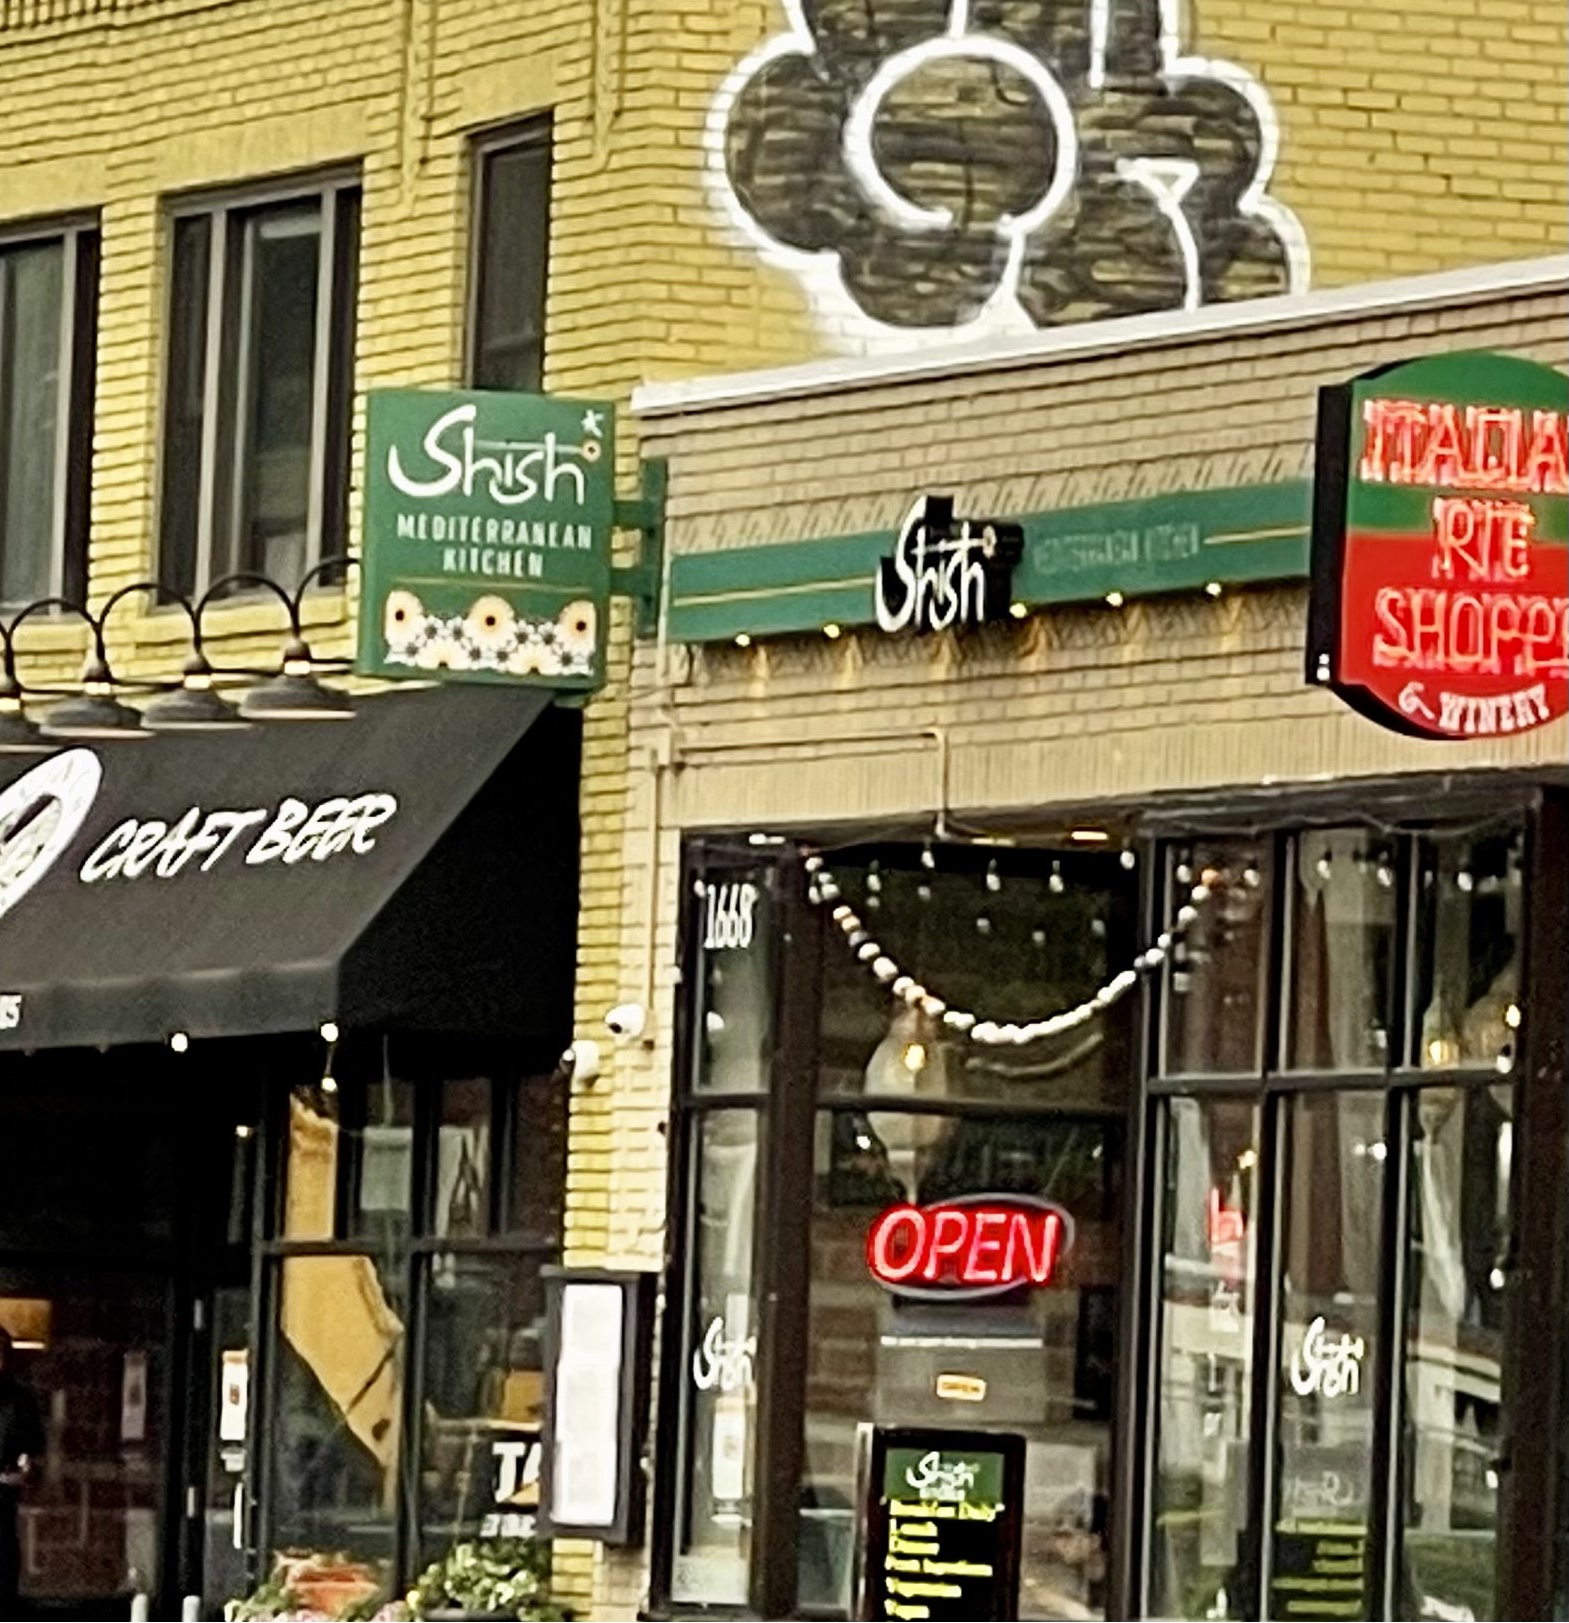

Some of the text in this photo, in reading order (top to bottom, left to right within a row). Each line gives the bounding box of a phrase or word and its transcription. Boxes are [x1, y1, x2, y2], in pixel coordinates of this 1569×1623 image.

[388, 403, 585, 505] Shish
[1359, 399, 1569, 494] ITALIA
[397, 512, 592, 549] MEDITERRANEAN
[442, 547, 544, 578] KITCHEN
[875, 495, 985, 633] Shish
[1373, 586, 1569, 678] SHOPP
[1438, 682, 1550, 733] WINERY
[80, 793, 397, 883] CRAFT BEER
[703, 883, 759, 949] 1668
[873, 1208, 1060, 1283] OPEN
